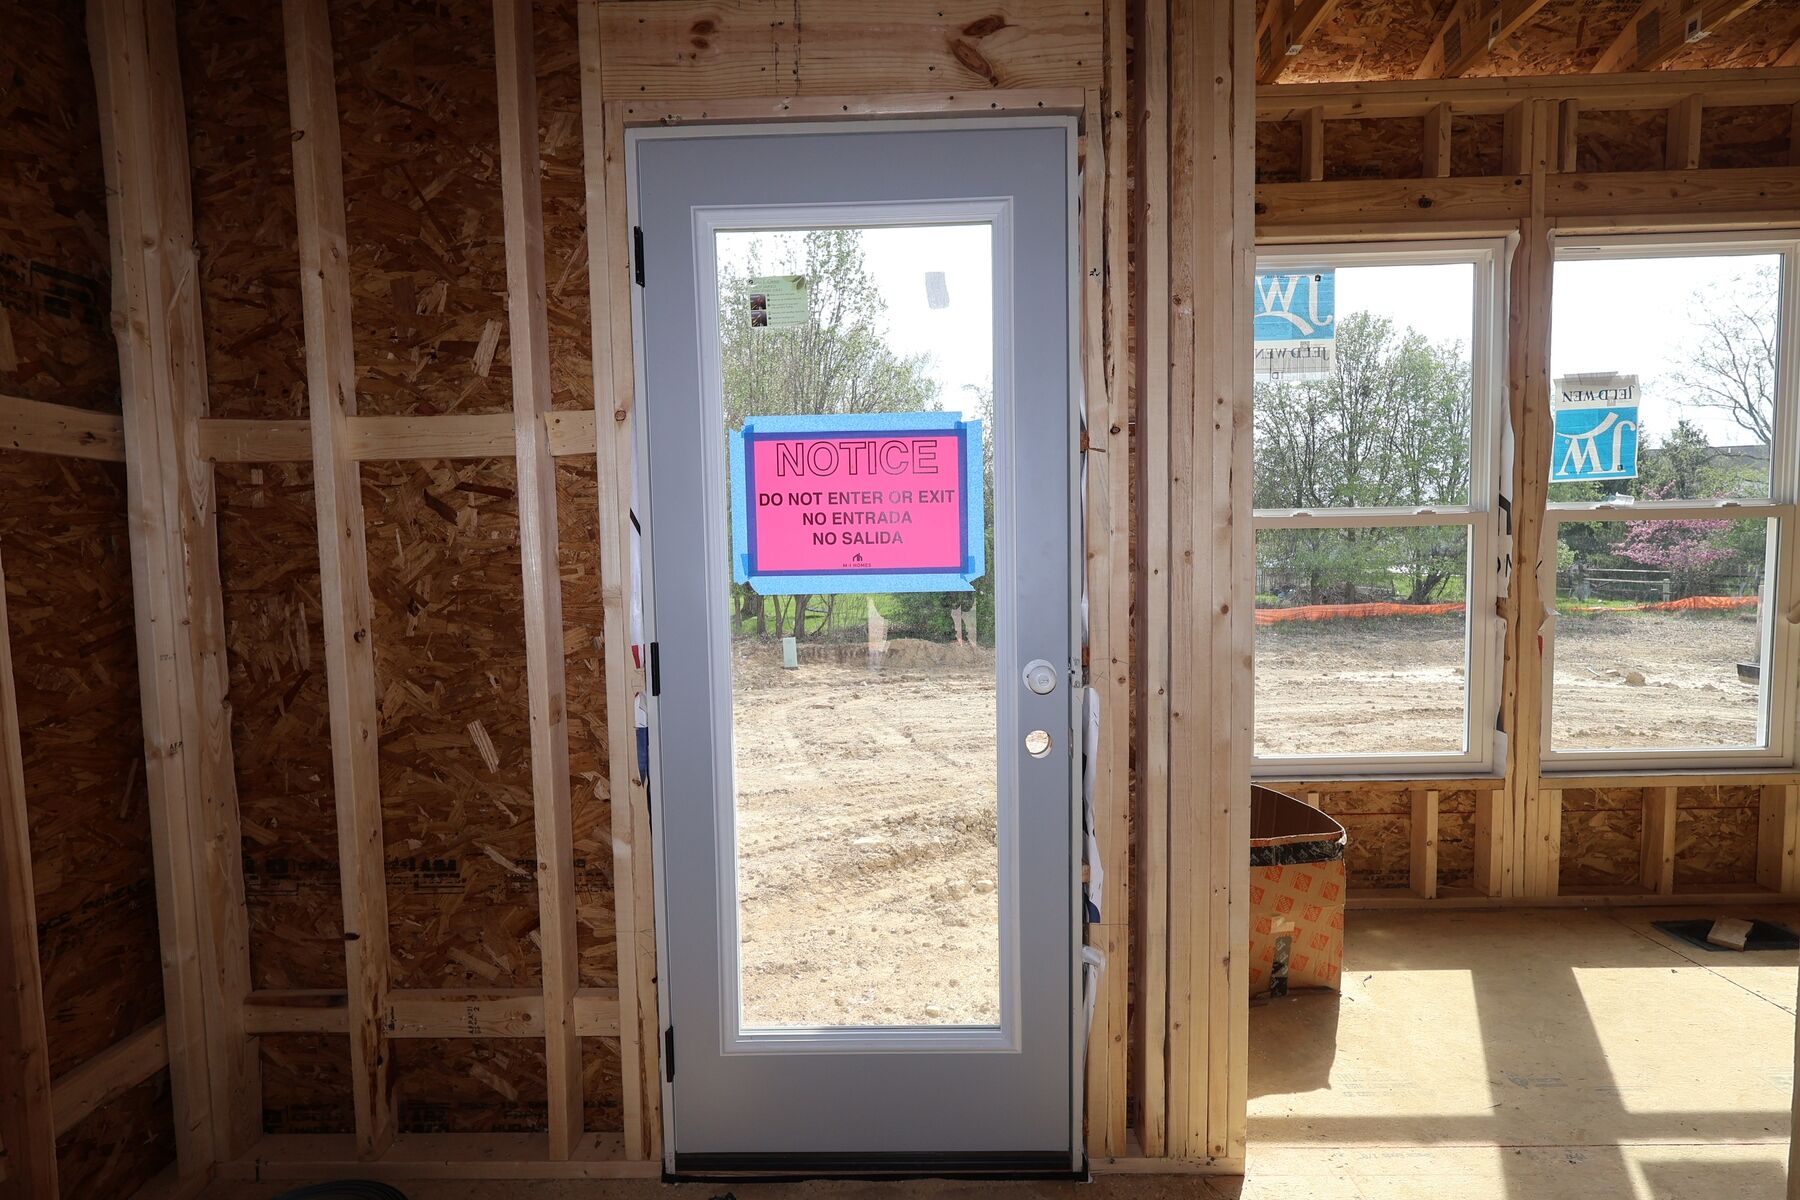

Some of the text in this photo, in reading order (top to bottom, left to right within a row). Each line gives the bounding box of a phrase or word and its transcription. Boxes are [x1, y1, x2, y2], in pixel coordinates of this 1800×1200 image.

[1561, 385, 1636, 402] JELD-WEN
[776, 440, 939, 477] NOTICE
[759, 489, 955, 507] DO NOT ENTER OR EXIT
[802, 510, 913, 526] NO ENTRADA
[812, 531, 904, 546] NO SALIDA
